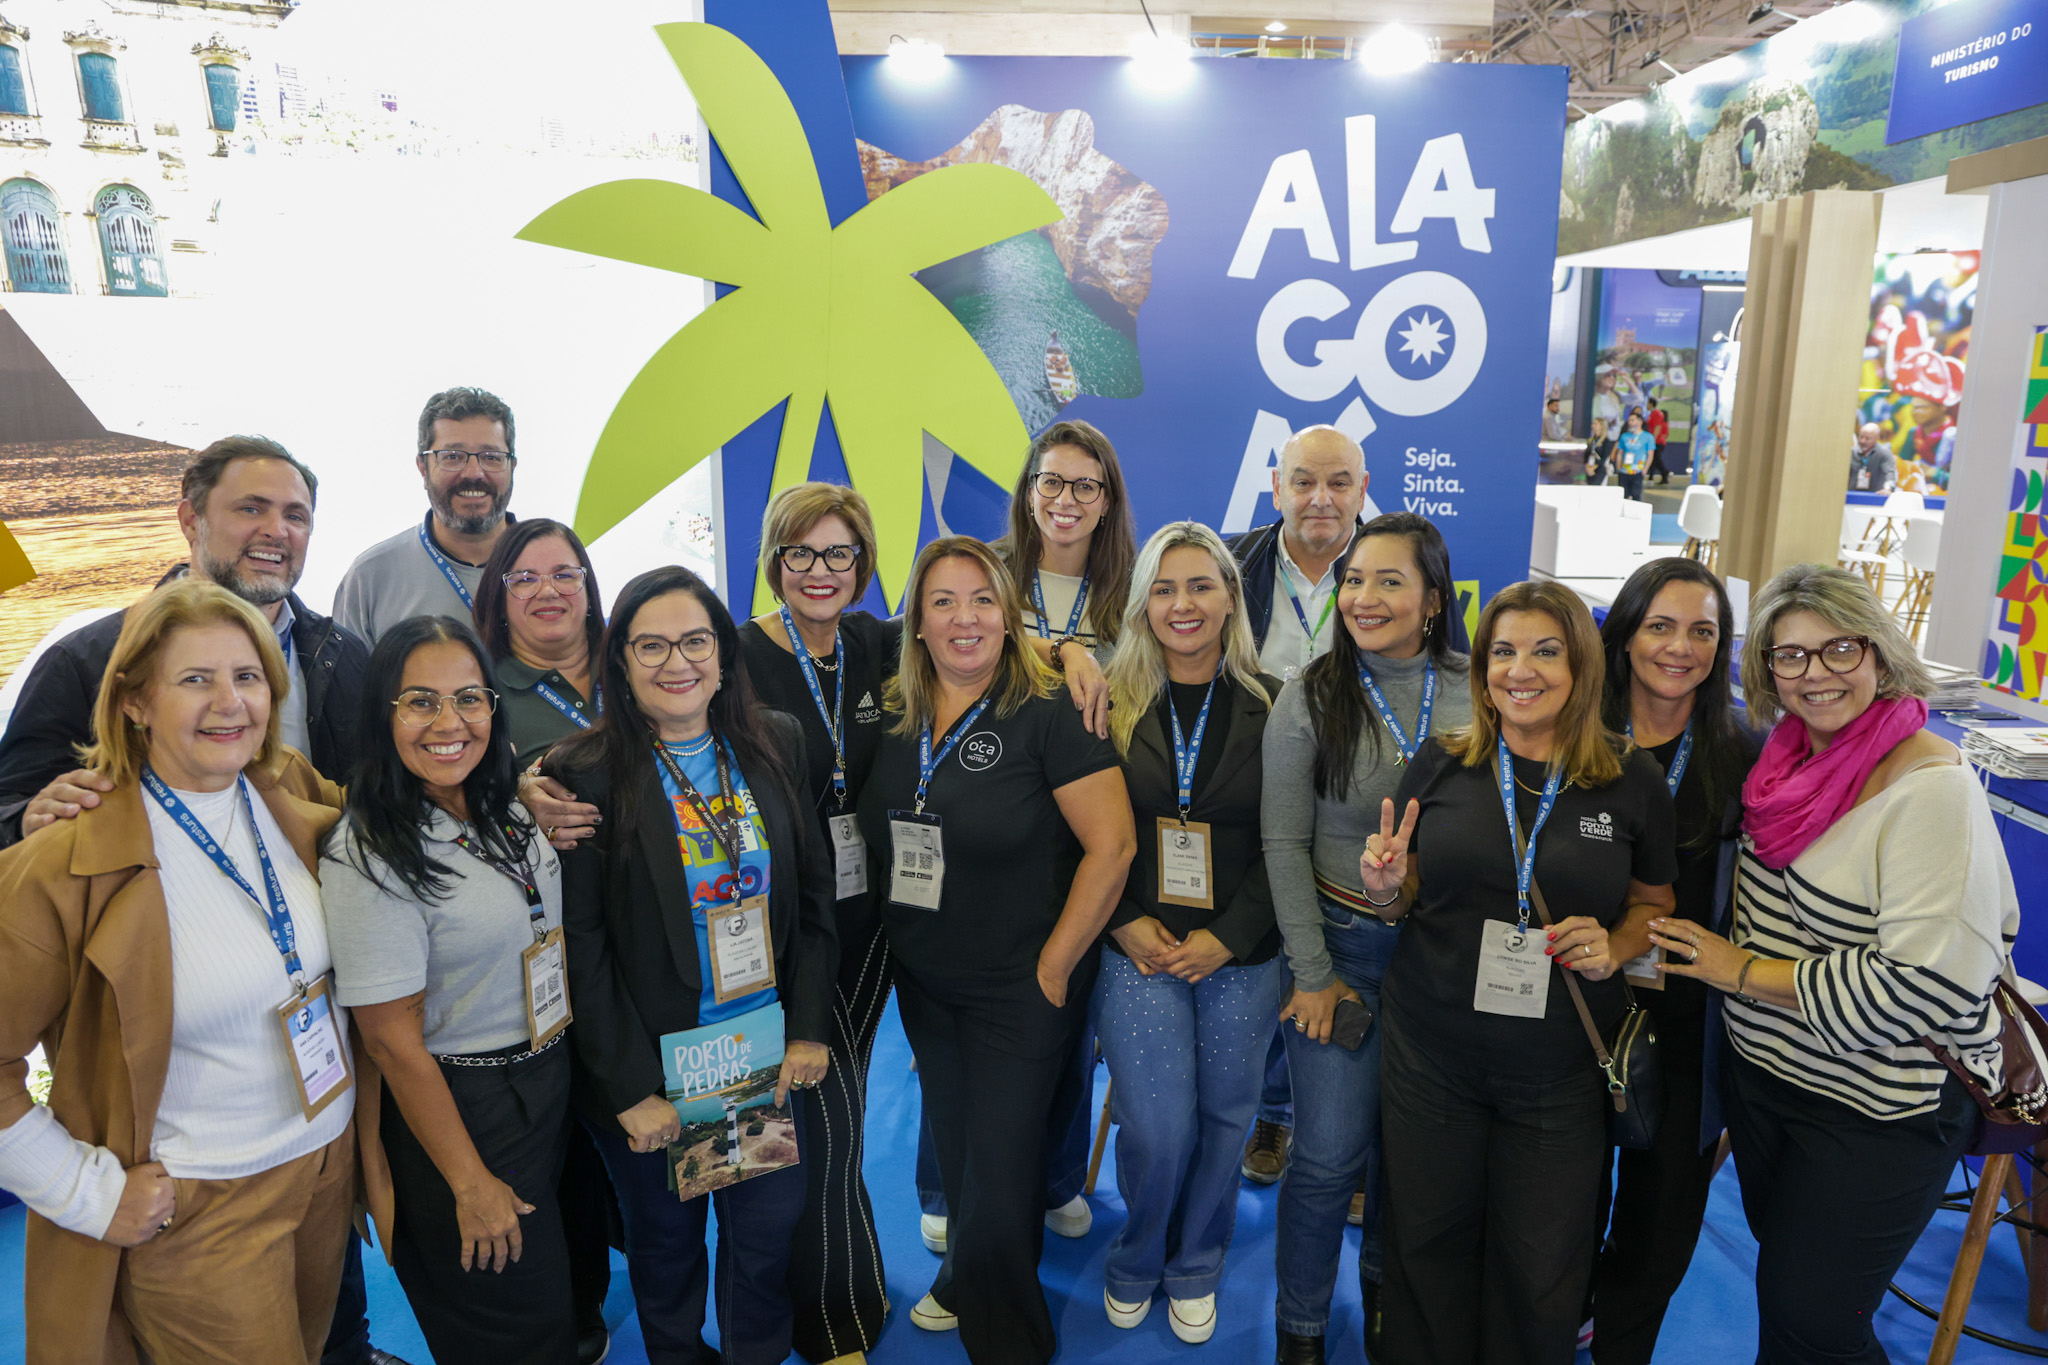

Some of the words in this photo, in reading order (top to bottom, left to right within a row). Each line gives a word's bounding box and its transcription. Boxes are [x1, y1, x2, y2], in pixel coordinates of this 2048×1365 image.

[1930, 32, 2007, 68] MINISTÉRIO
[2011, 23, 2032, 41] DO
[1944, 55, 1999, 84] TURISMO
[1227, 114, 1496, 280] ALA
[1404, 446, 1457, 472] Seja.
[1403, 472, 1465, 494] Sinta.
[1403, 496, 1458, 516] Viva.
[1579, 826, 1613, 838] VERDE
[674, 1033, 738, 1075] PORTO
[740, 1040, 753, 1055] DE
[682, 1055, 752, 1098] PEDRAS
